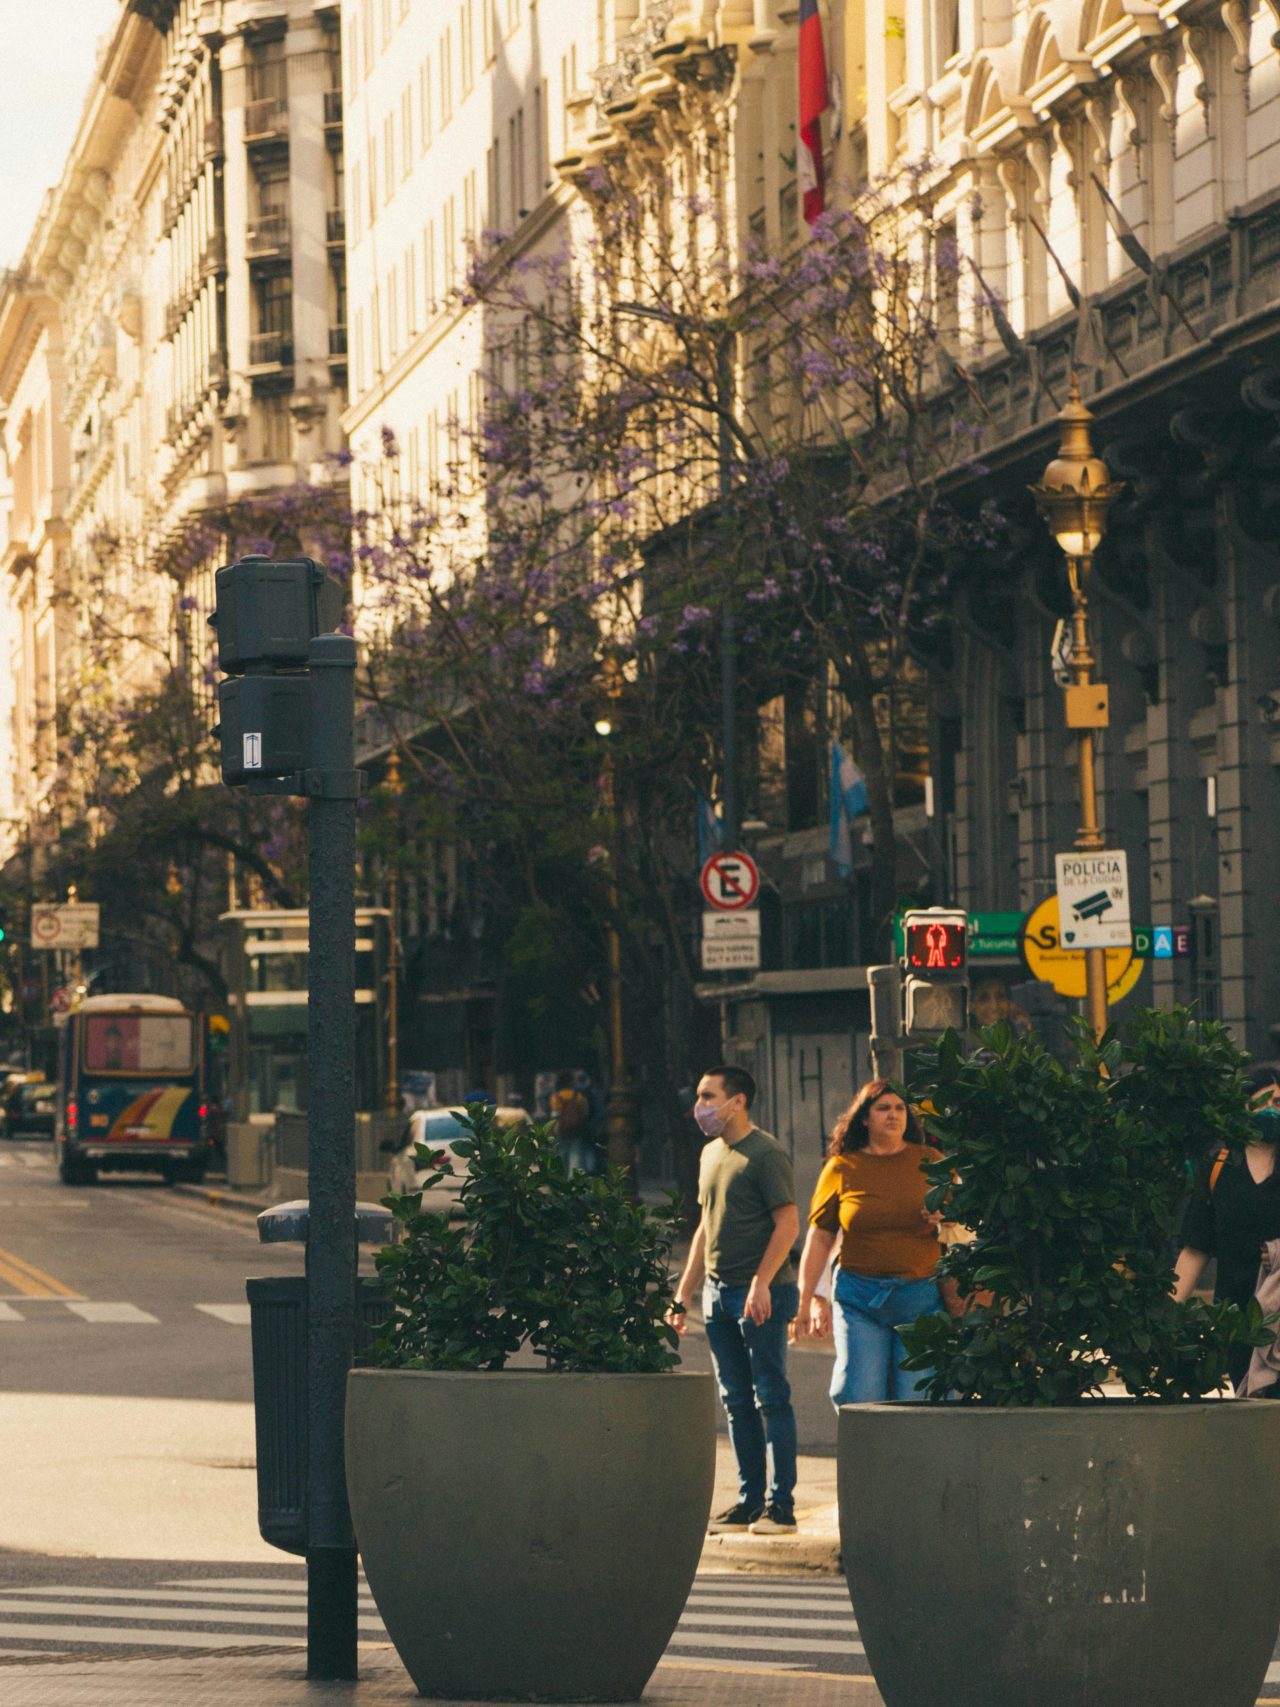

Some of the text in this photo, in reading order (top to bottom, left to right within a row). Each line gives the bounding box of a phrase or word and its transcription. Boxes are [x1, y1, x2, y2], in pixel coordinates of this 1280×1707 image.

[1062, 861, 1121, 877] POLICIA
[719, 864, 741, 898] E
[1135, 933, 1150, 952] D
[1154, 933, 1172, 952] A
[1176, 934, 1188, 952] E
